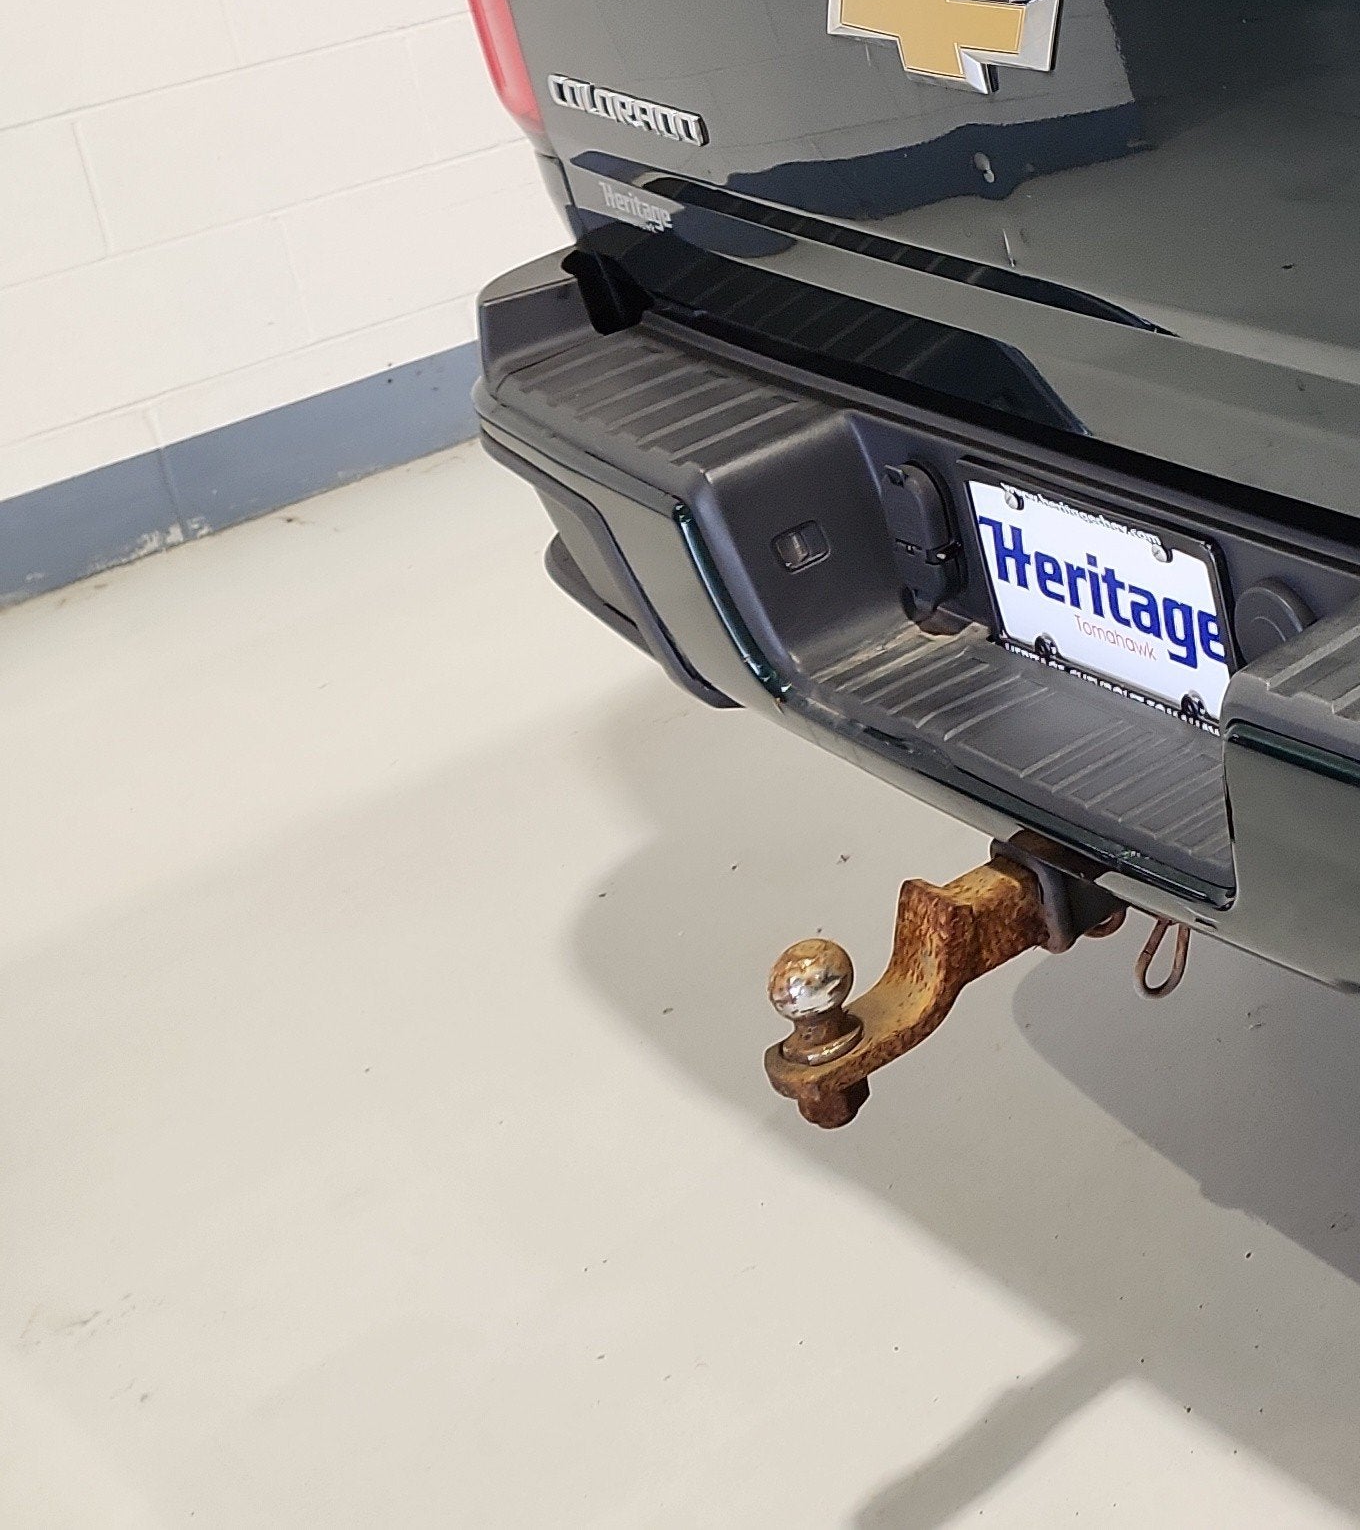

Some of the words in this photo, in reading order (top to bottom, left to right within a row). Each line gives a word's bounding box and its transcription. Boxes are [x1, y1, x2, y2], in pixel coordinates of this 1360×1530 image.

[547, 73, 710, 147] COLORADO
[599, 181, 673, 234] Heritage
[978, 515, 1227, 670] Heritage
[1073, 614, 1158, 662] Tomahawk
